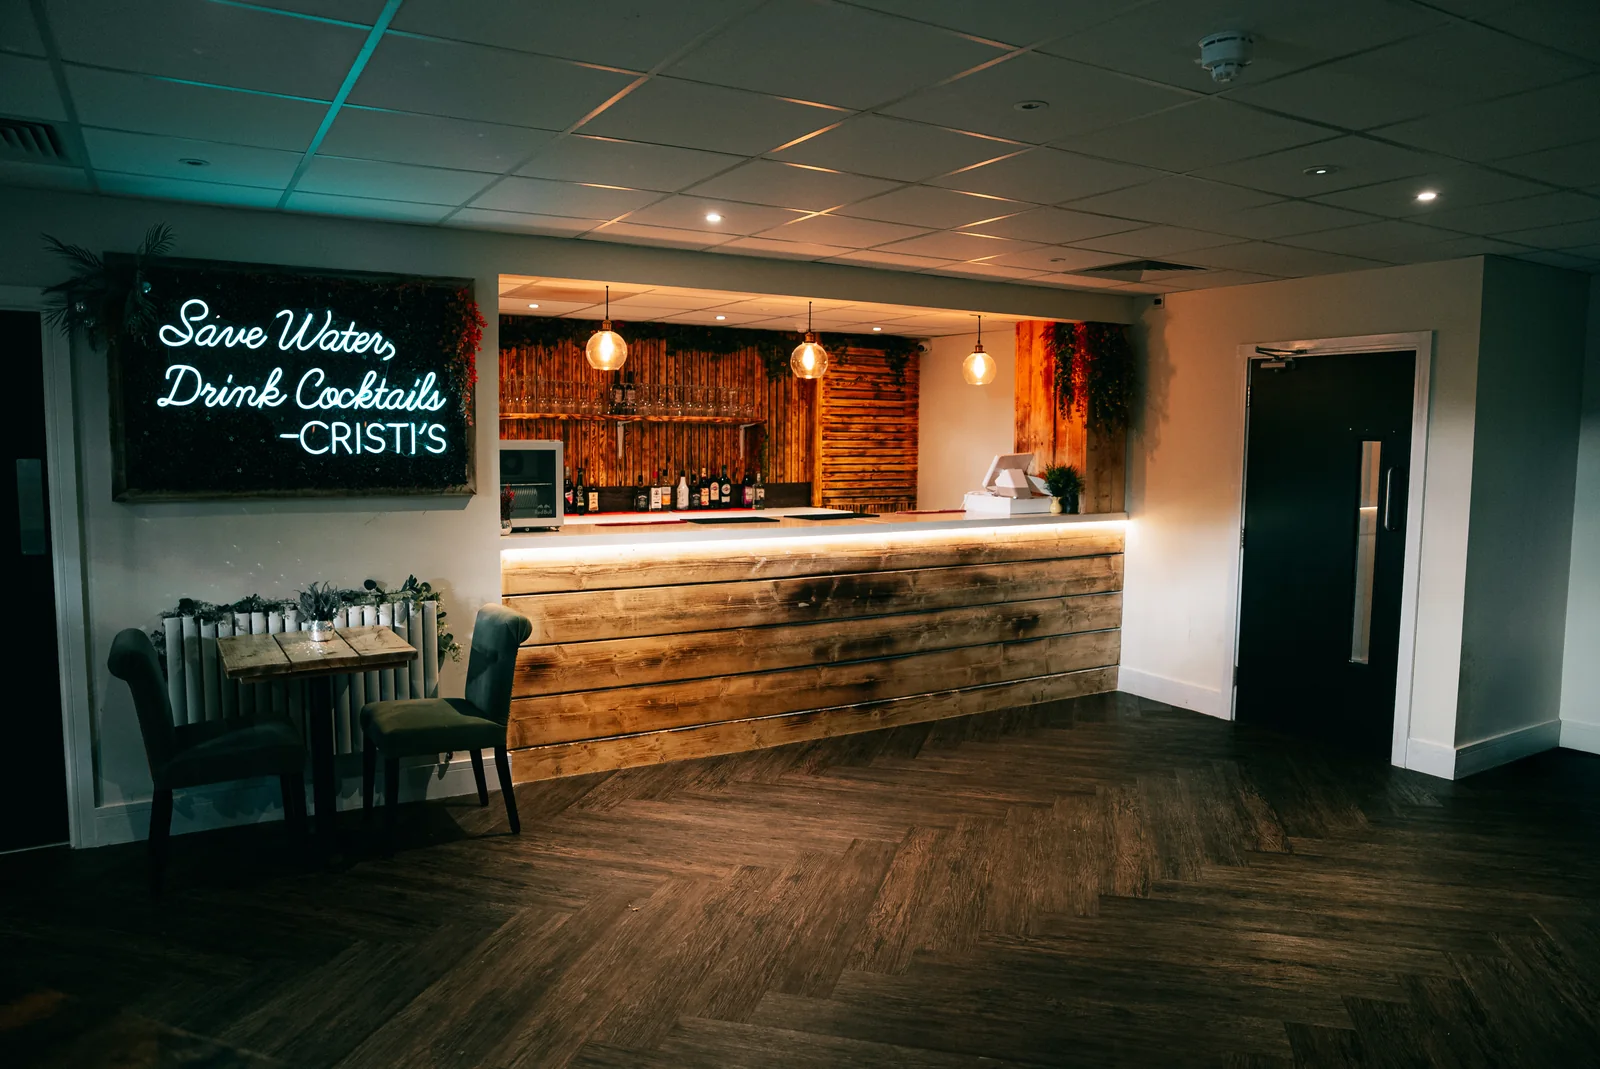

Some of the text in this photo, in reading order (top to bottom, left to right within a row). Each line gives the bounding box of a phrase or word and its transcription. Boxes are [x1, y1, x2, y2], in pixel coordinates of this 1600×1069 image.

[158, 298, 396, 361] Save Water,
[157, 364, 447, 412] Drink Cocktails
